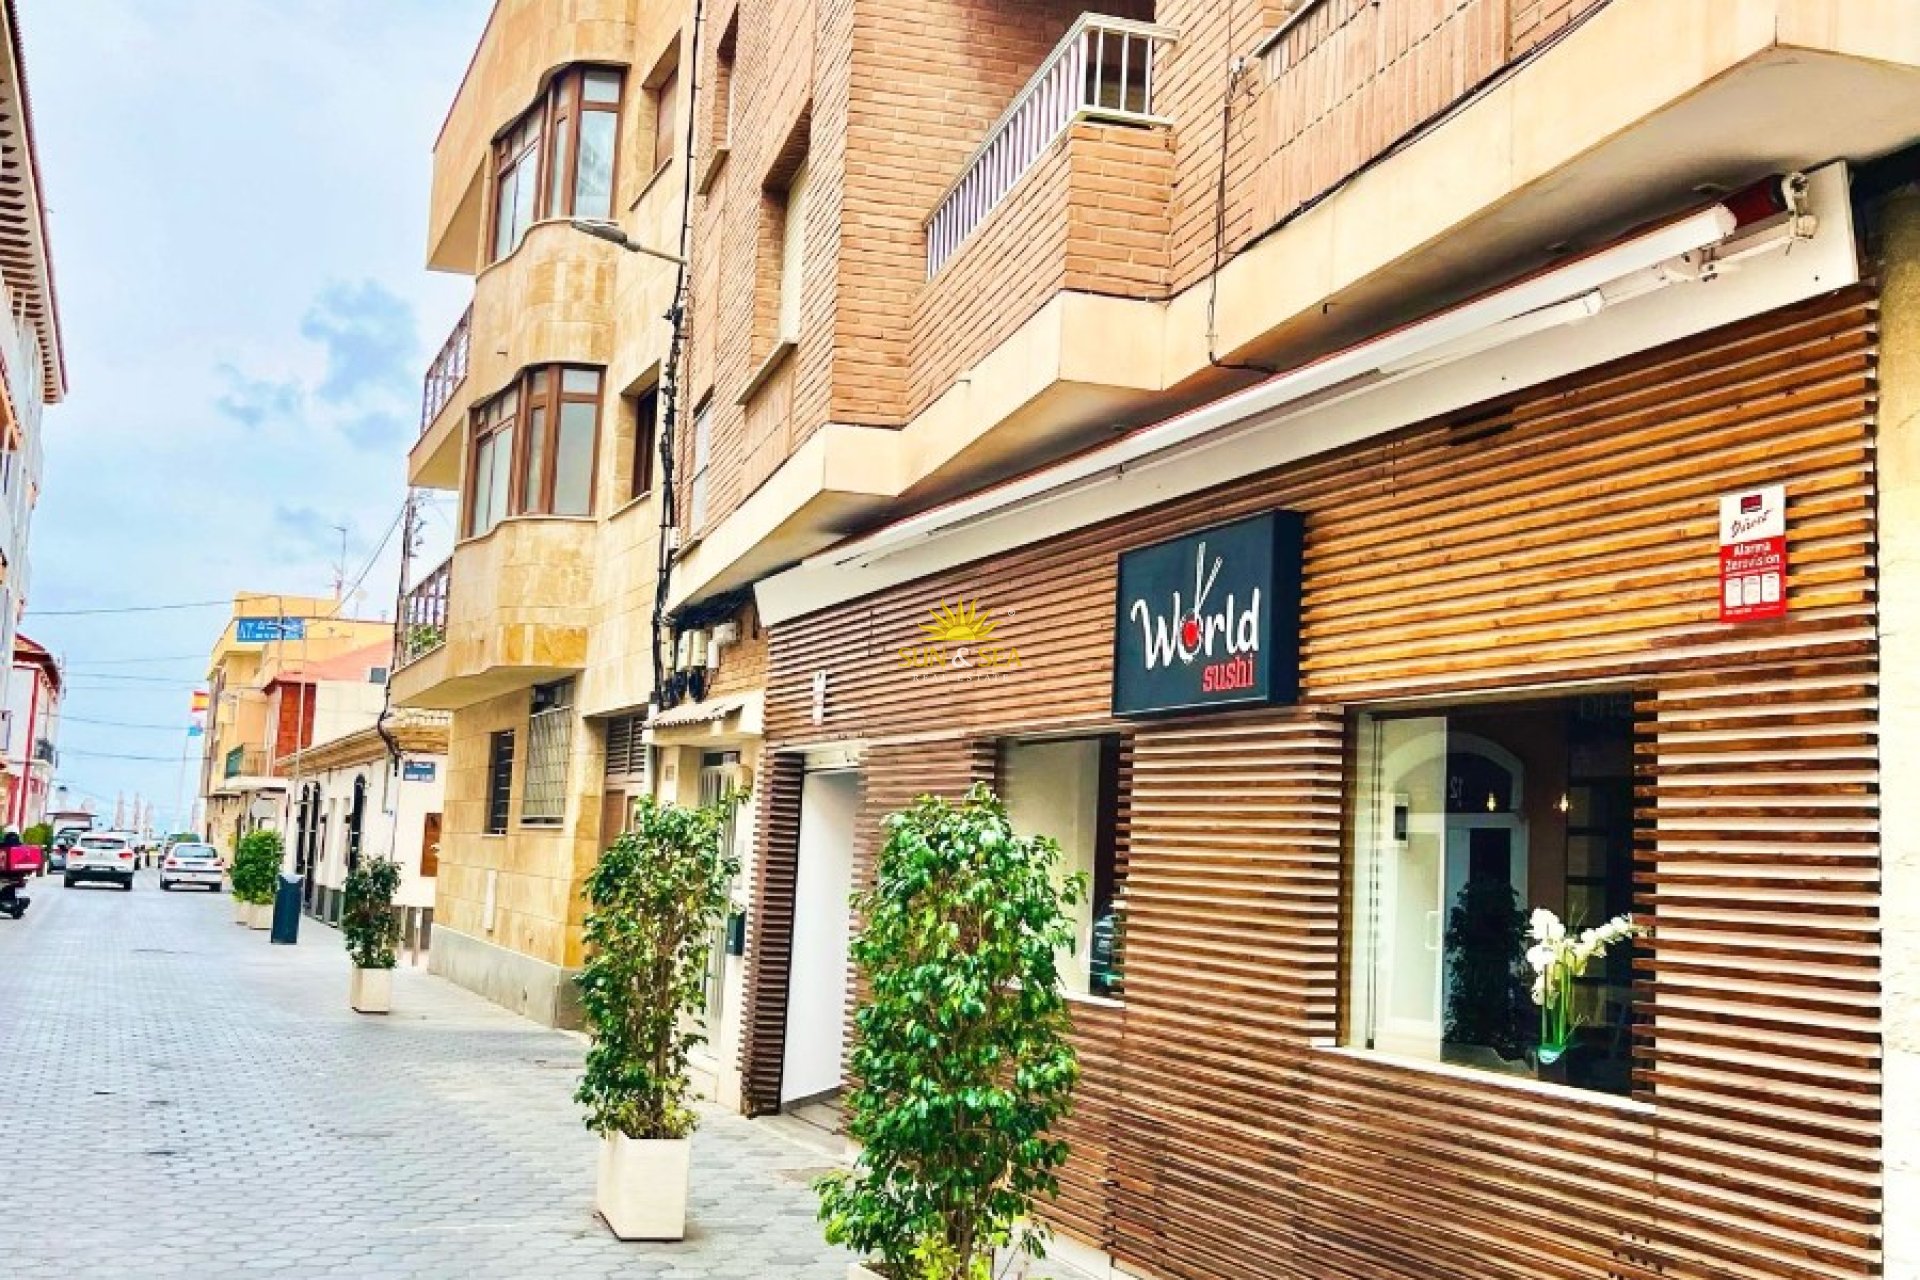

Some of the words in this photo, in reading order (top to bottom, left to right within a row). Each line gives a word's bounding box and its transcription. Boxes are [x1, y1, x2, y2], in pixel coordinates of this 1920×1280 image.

[1734, 542, 1772, 556] Alarma
[1130, 587, 1261, 670] World
[1202, 652, 1254, 692] sushi
